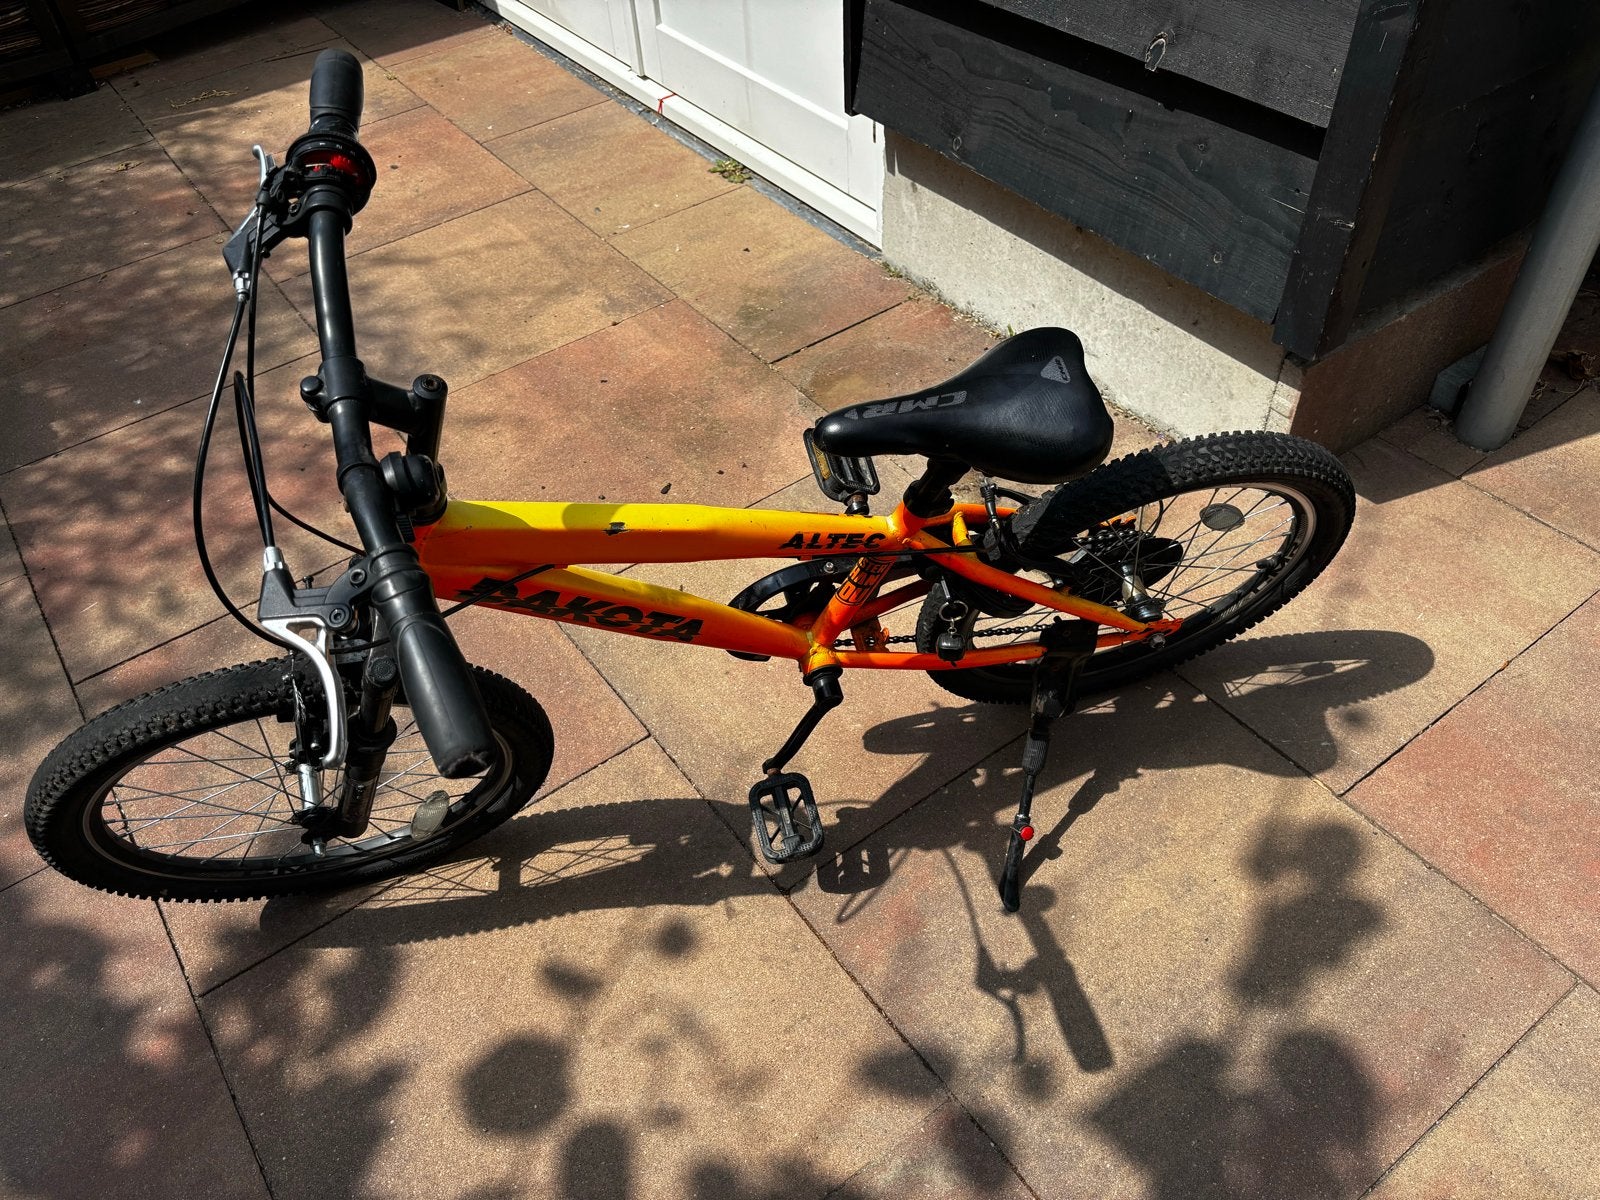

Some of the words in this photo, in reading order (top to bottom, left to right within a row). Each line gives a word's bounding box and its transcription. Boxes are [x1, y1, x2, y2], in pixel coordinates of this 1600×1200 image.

[863, 390, 967, 418] CMR
[779, 532, 886, 550] ALTEC
[457, 577, 703, 642] DAKOTA
